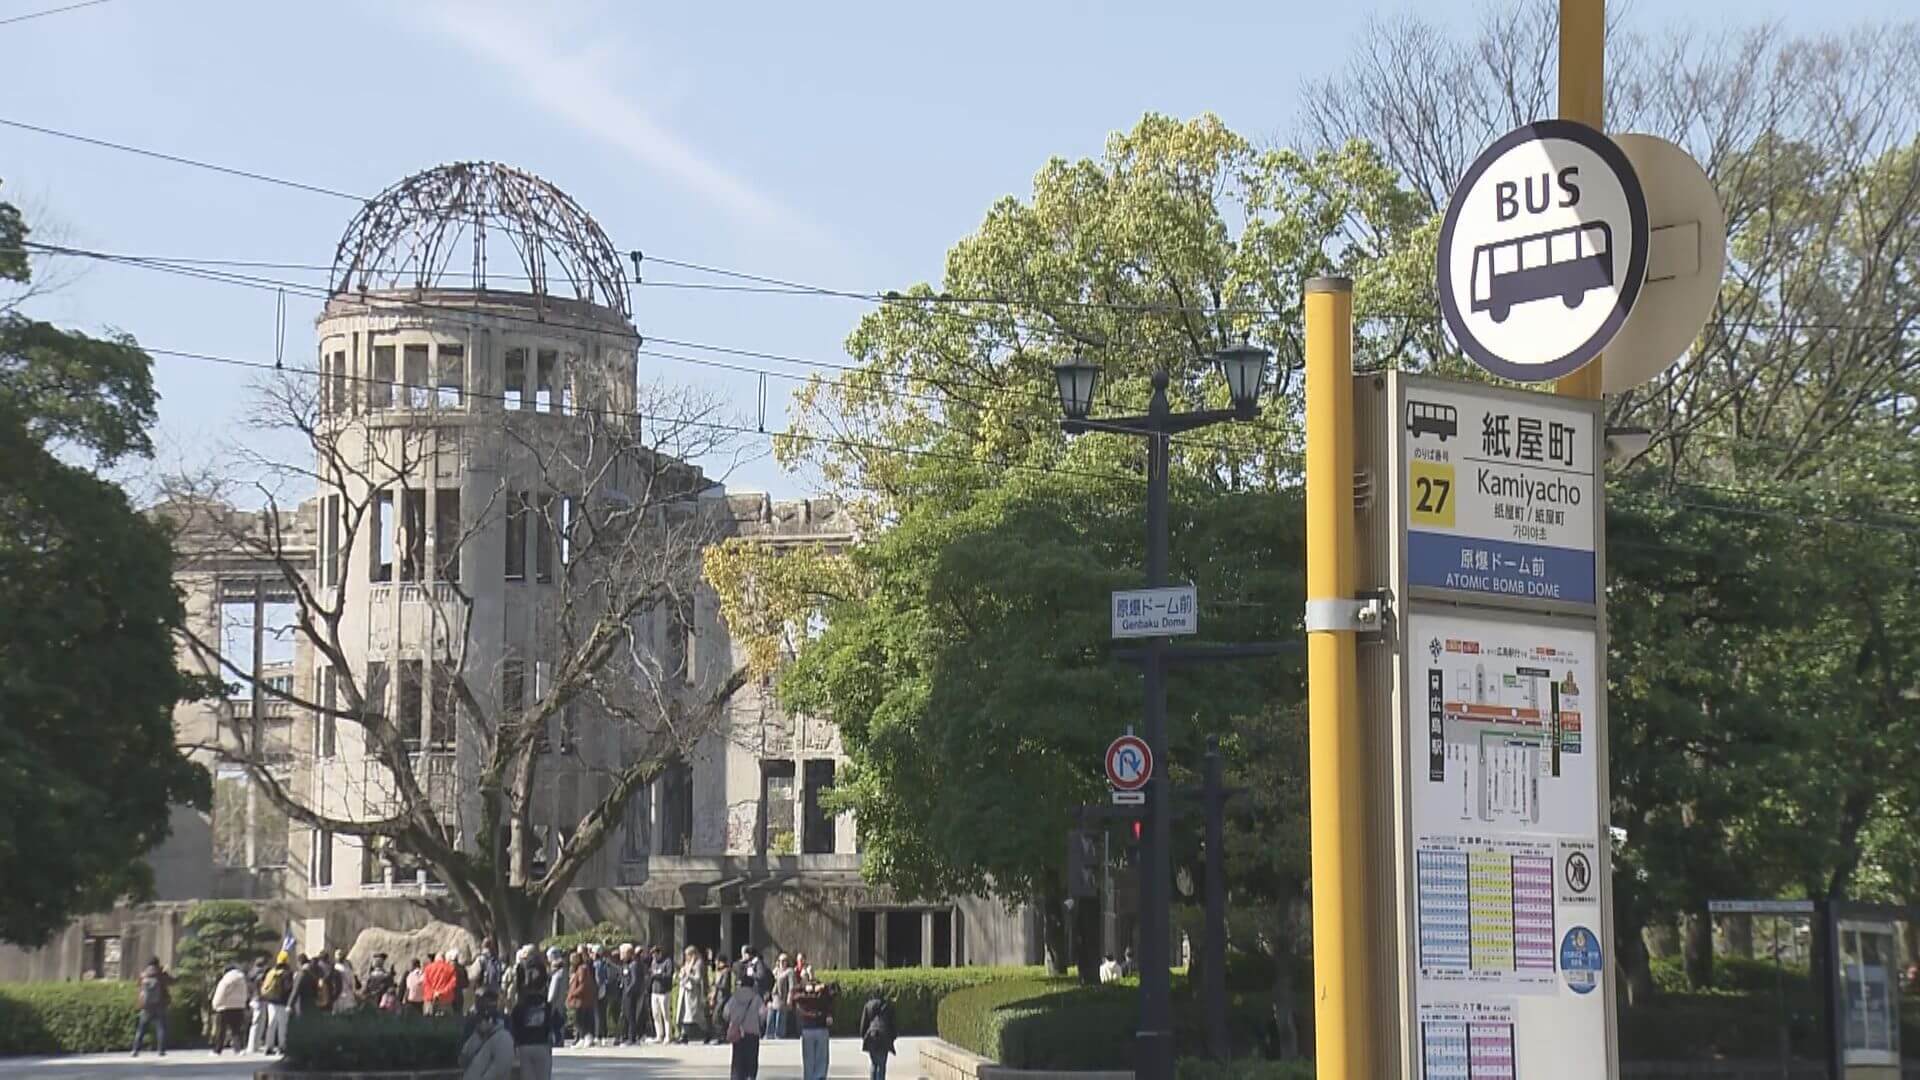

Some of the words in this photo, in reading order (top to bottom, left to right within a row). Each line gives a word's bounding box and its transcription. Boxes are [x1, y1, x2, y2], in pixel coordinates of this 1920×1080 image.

[1496, 166, 1581, 222] BUS
[1482, 411, 1576, 466] 紙屋町
[1414, 447, 1449, 462] のりば番号
[1416, 477, 1450, 514] 27
[1478, 467, 1581, 507] Kamiyacho
[1513, 524, 1547, 540] 가미야초
[1460, 548, 1545, 577] 原爆ドーム前
[1446, 572, 1490, 590] ATOMIC
[1493, 577, 1525, 594] BOMB
[1528, 581, 1560, 598] DOME
[1117, 594, 1192, 618] 原爆ドーム前
[1162, 616, 1186, 628] Dome
